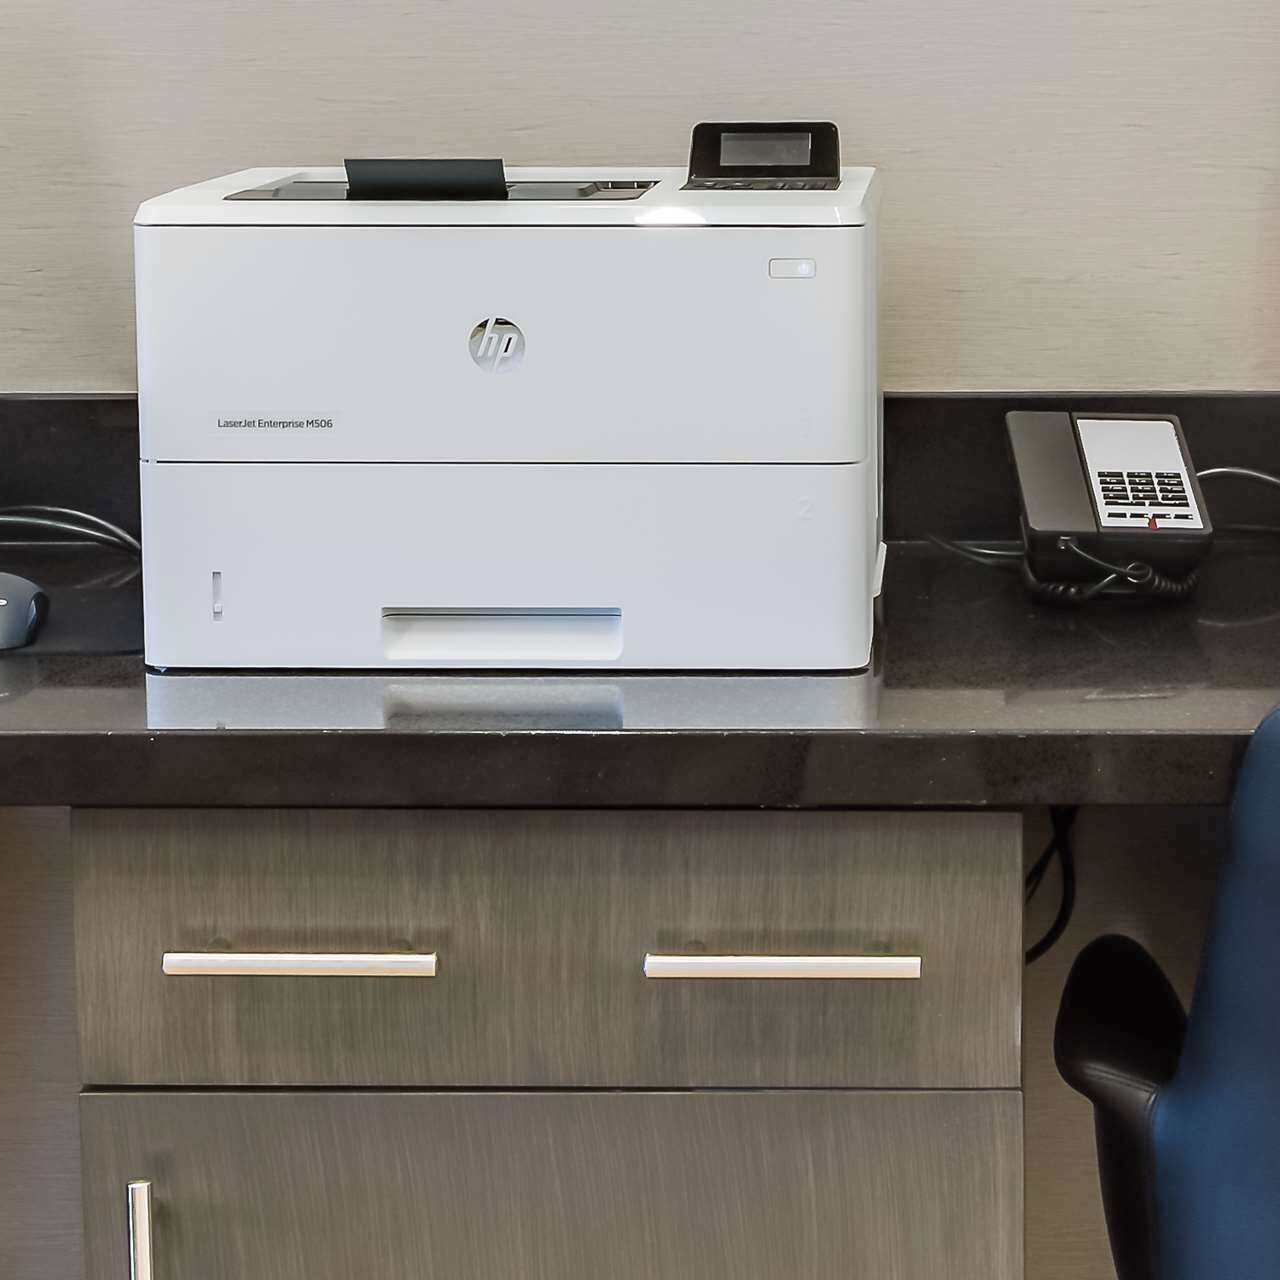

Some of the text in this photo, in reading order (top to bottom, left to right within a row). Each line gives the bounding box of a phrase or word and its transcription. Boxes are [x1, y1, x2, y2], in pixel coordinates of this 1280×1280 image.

[477, 317, 519, 375] hp
[217, 418, 333, 430] LaserJet Enterprise M506
